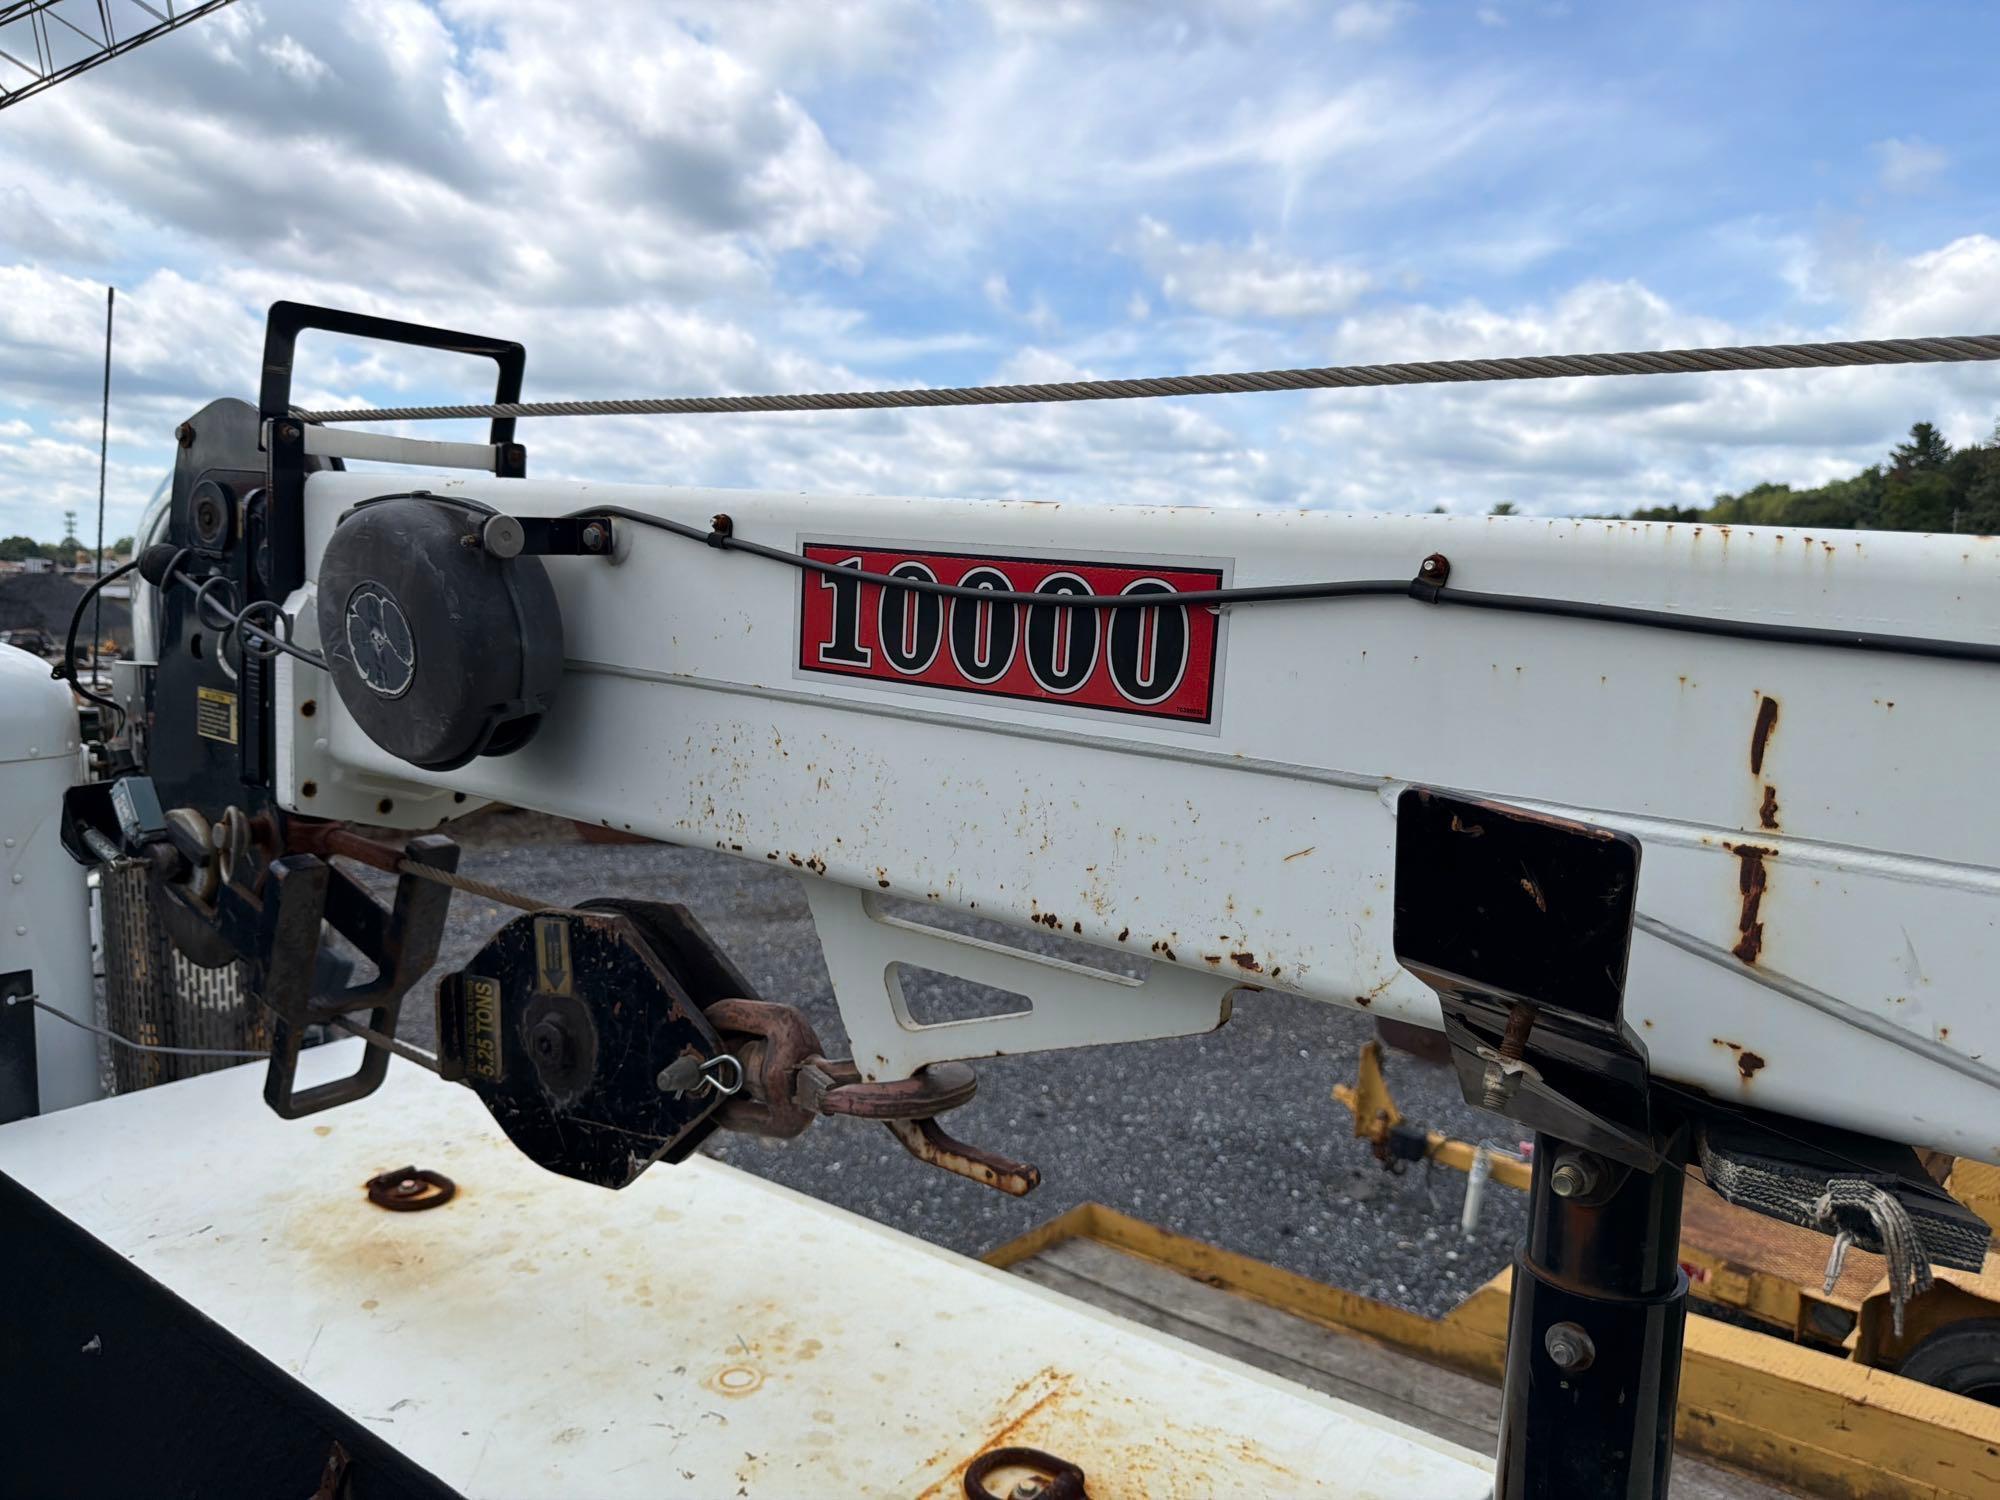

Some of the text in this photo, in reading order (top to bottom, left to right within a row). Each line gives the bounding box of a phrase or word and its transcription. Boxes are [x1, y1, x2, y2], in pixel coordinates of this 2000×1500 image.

[818, 556, 1190, 705] 10000
[475, 982, 495, 1077] 5.25 TONS
